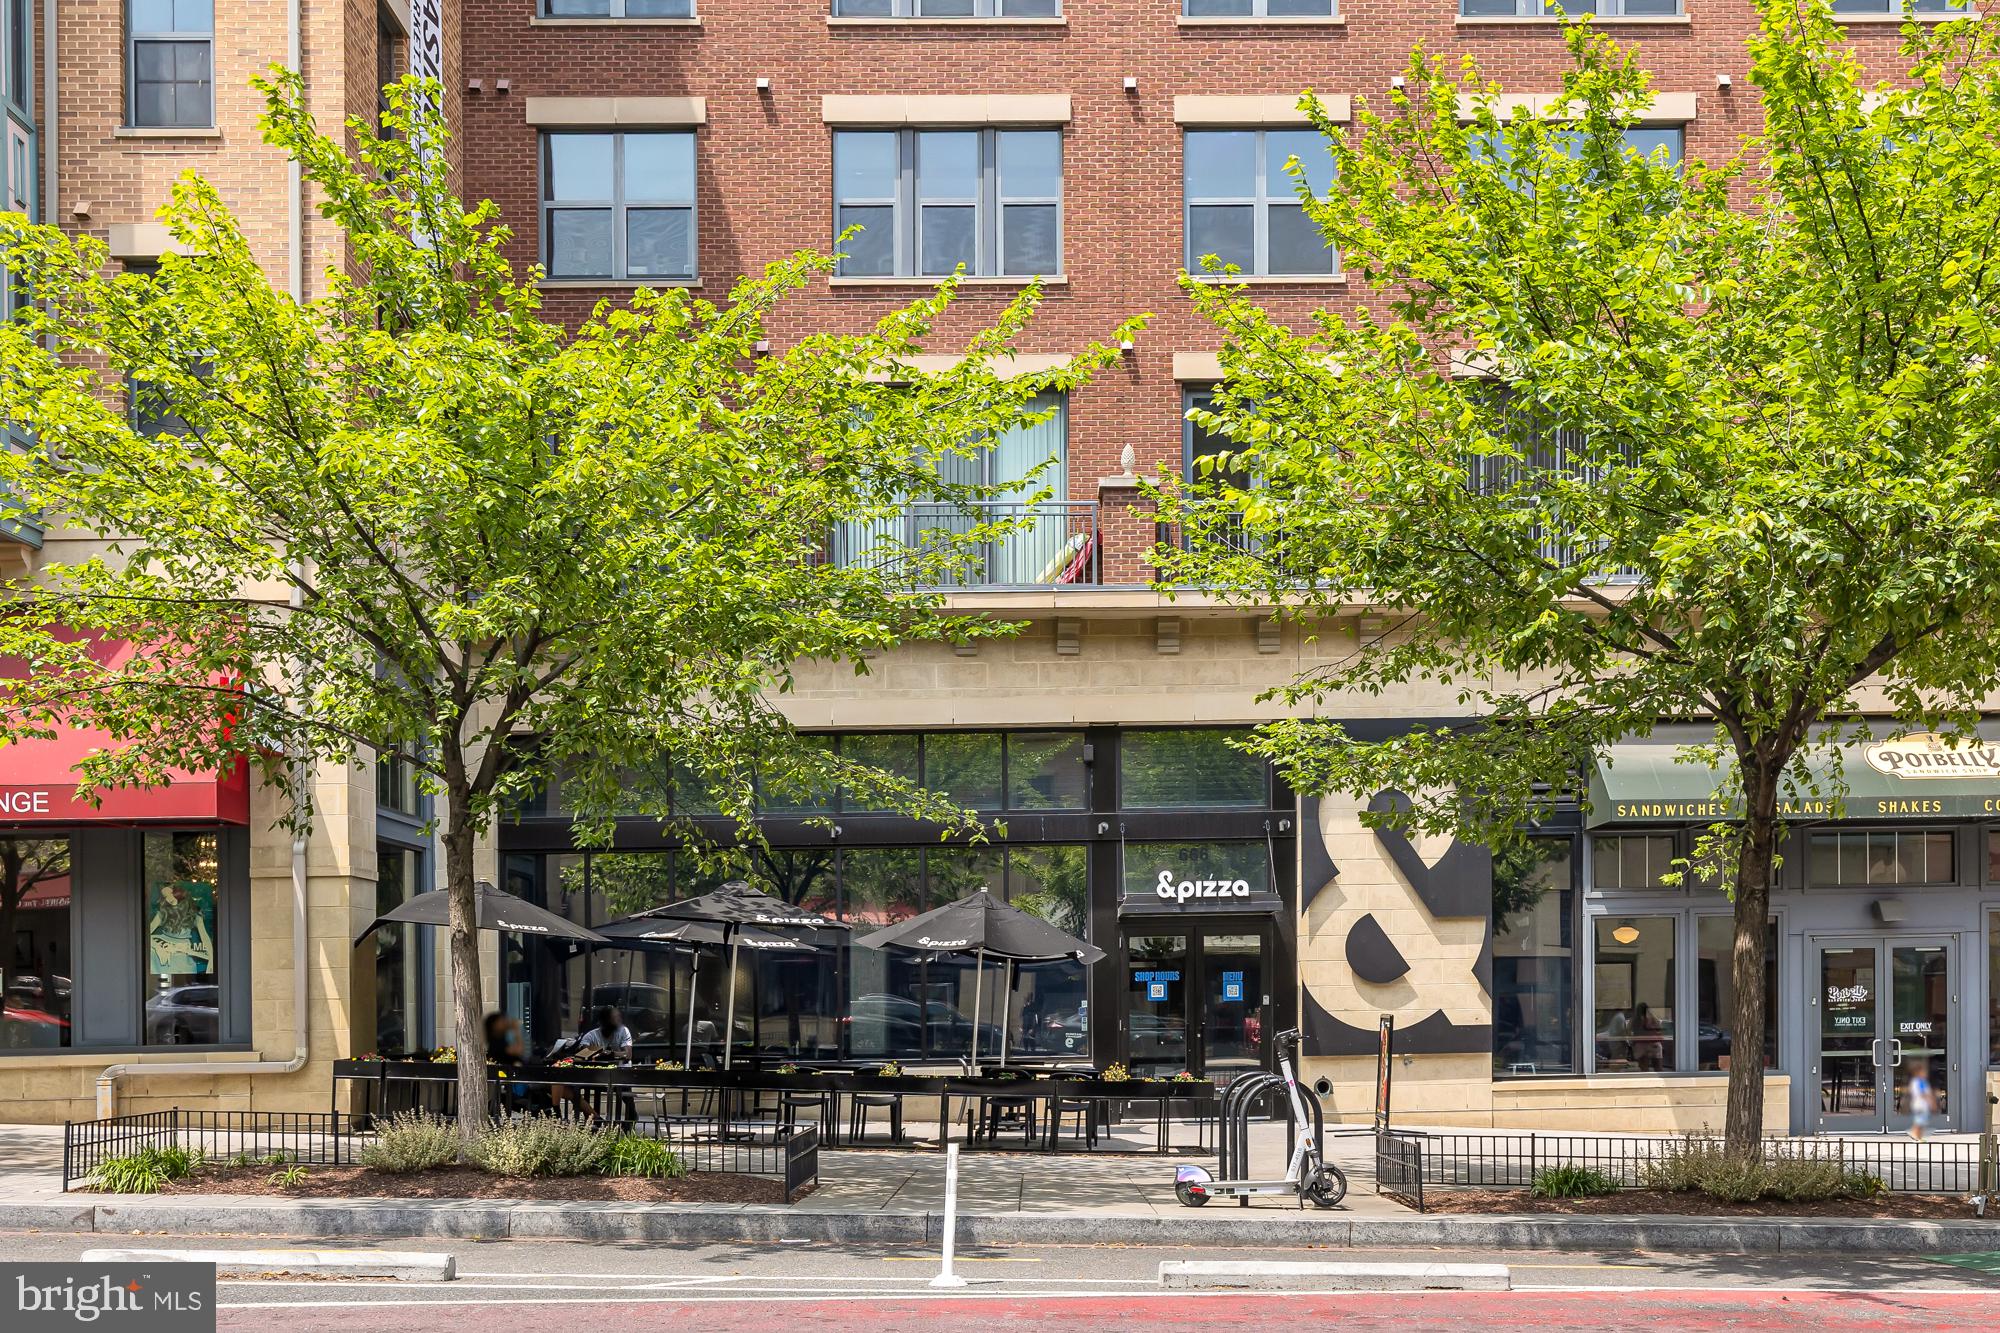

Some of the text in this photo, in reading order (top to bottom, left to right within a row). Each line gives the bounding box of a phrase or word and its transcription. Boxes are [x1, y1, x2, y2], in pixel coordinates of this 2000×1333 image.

[1879, 748, 2000, 770] POTBELLY
[1617, 803, 1727, 817] SANDWICHES
[1878, 800, 1942, 813] SHAKES
[917, 936, 968, 948] &pizza
[1134, 970, 1180, 981] SHOP HOURS
[1900, 1022, 1915, 1030] EXIT
[1915, 1022, 1932, 1030] ONLY
